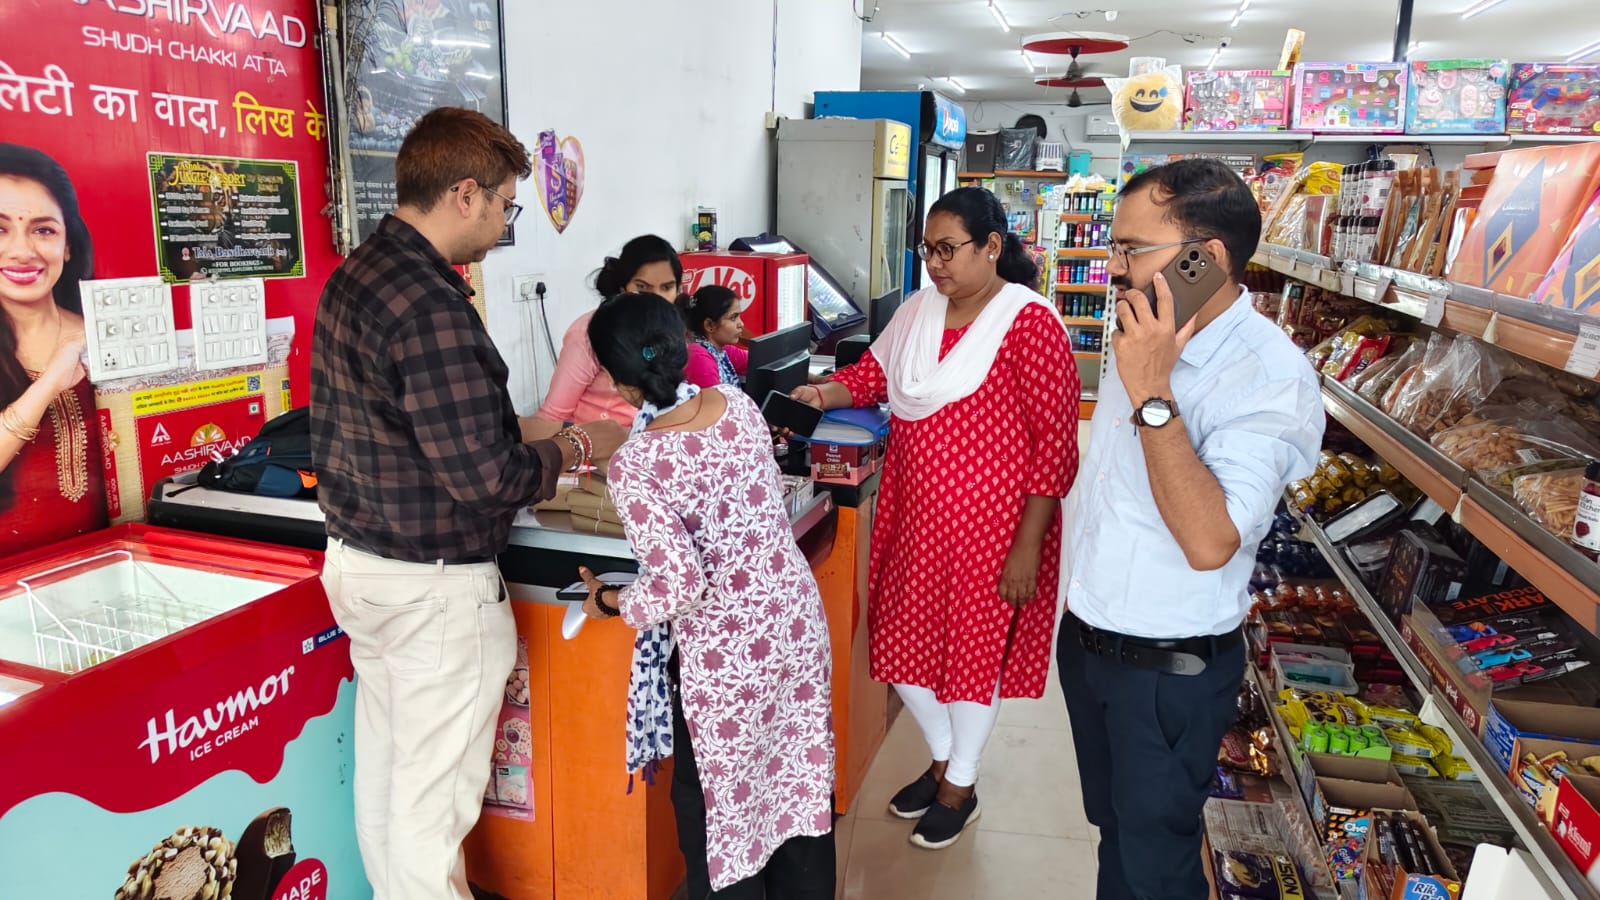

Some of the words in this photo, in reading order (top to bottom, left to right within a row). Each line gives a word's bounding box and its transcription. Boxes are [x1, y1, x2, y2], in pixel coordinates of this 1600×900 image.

[73, 0, 307, 48] SHIRVAAD
[82, 25, 163, 57] SHUDH
[168, 41, 237, 69] CHAKKI
[243, 54, 288, 77] ATTA
[89, 84, 139, 123] का
[152, 91, 227, 138] वादा,
[232, 90, 296, 138] लिख
[303, 99, 326, 141] के
[160, 434, 252, 467] AASHIRVAAD
[137, 665, 296, 765] Havmor
[190, 741, 212, 761] ICE
[215, 716, 259, 747] CREAM
[1413, 881, 1438, 896] Rik
